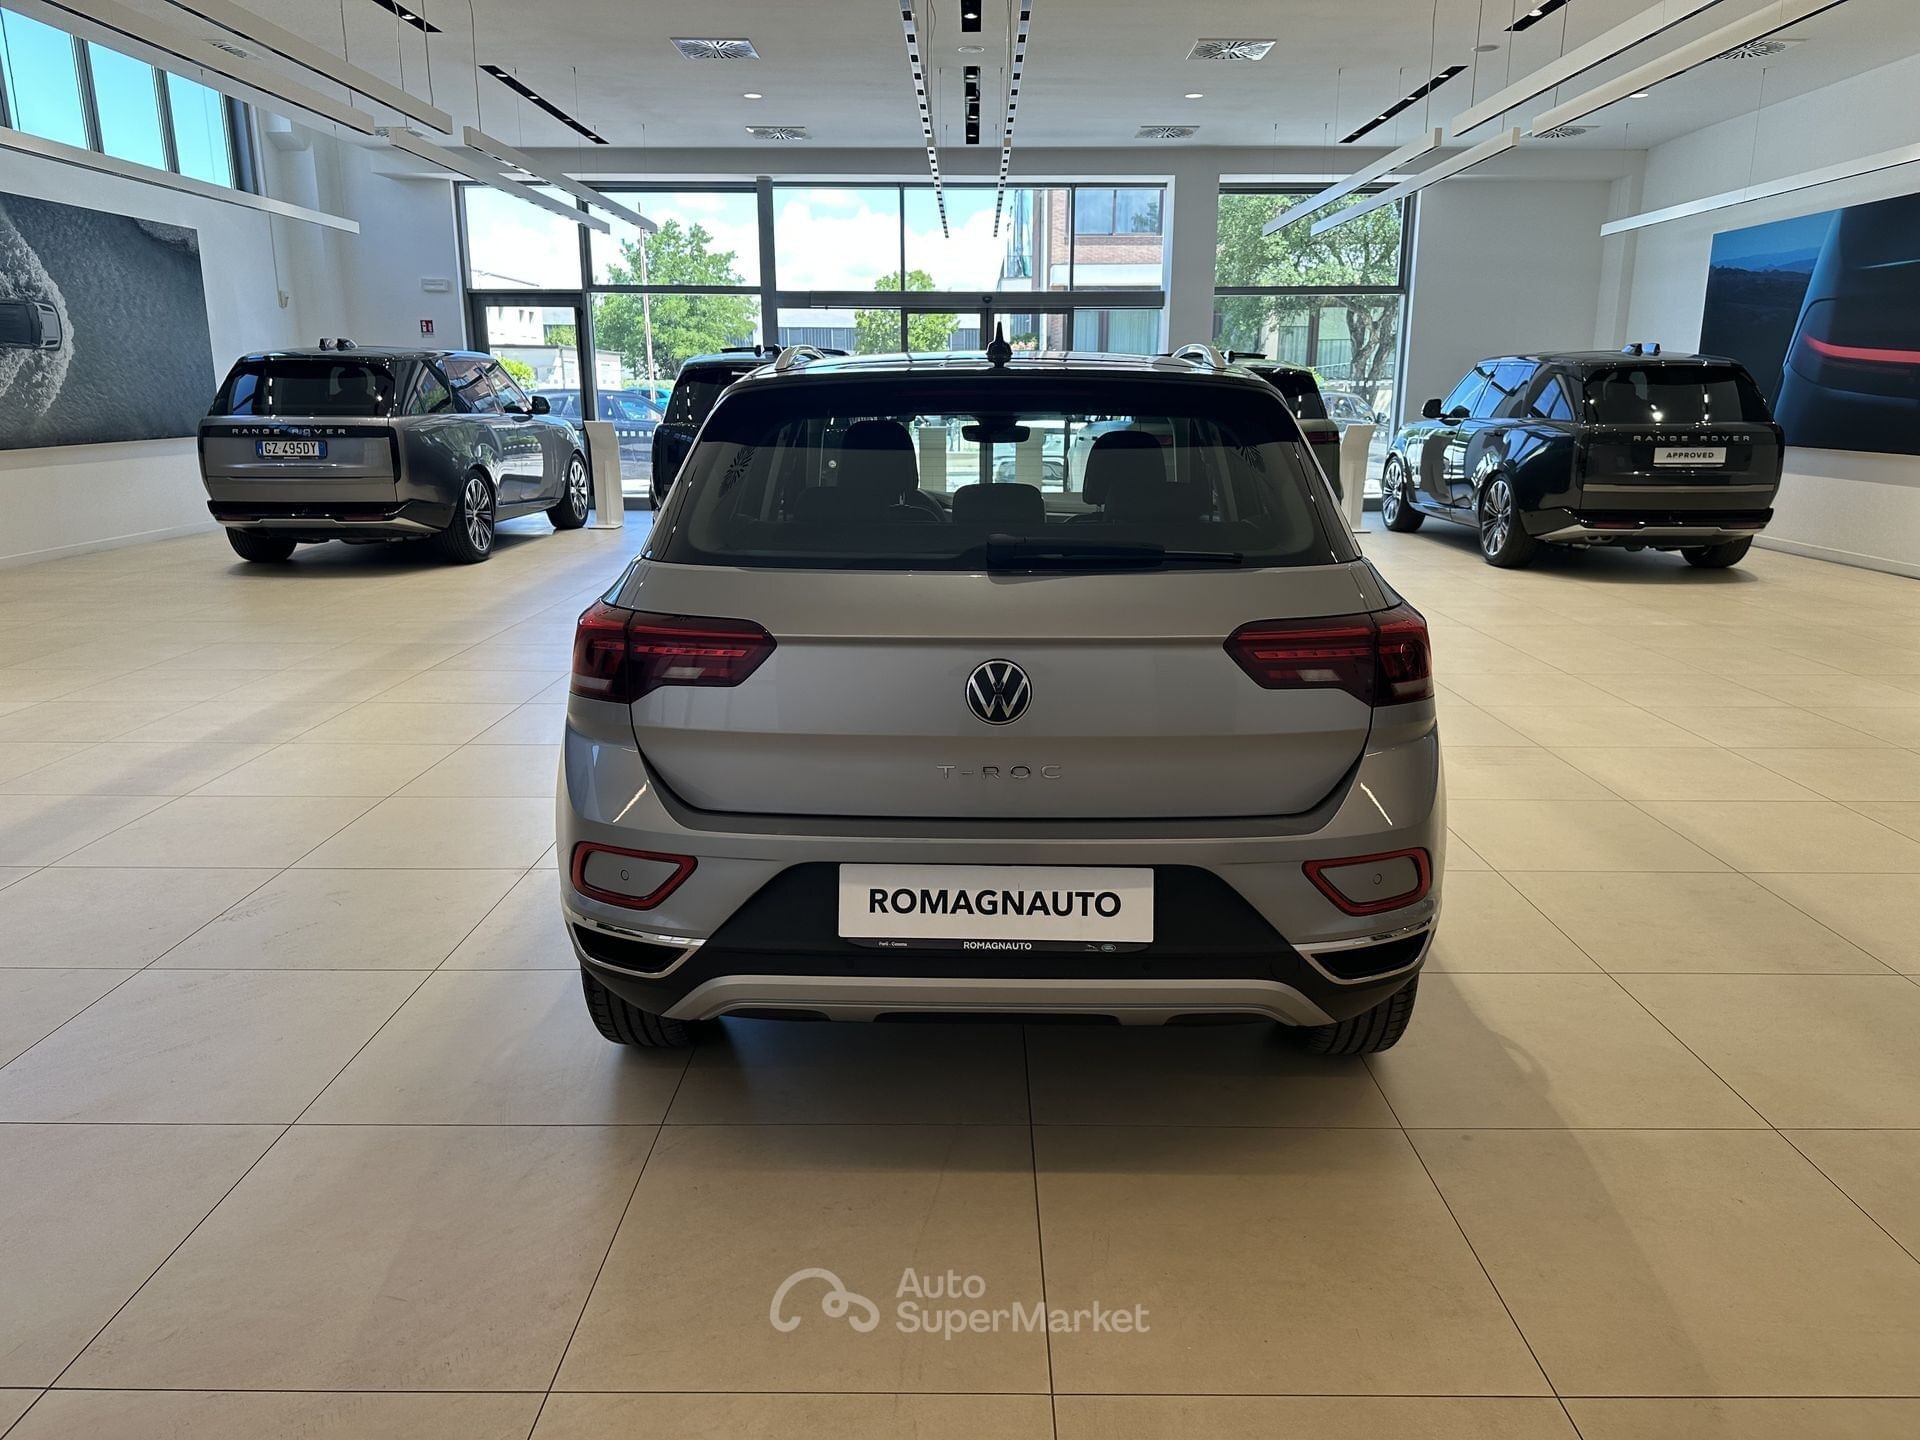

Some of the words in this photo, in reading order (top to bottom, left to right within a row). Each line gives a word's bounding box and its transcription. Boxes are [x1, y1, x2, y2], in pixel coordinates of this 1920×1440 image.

[936, 765, 1062, 780] T-ROC
[868, 888, 1122, 917] ROMAGNAUTO
[963, 941, 1032, 951] ROMAGNAUTO
